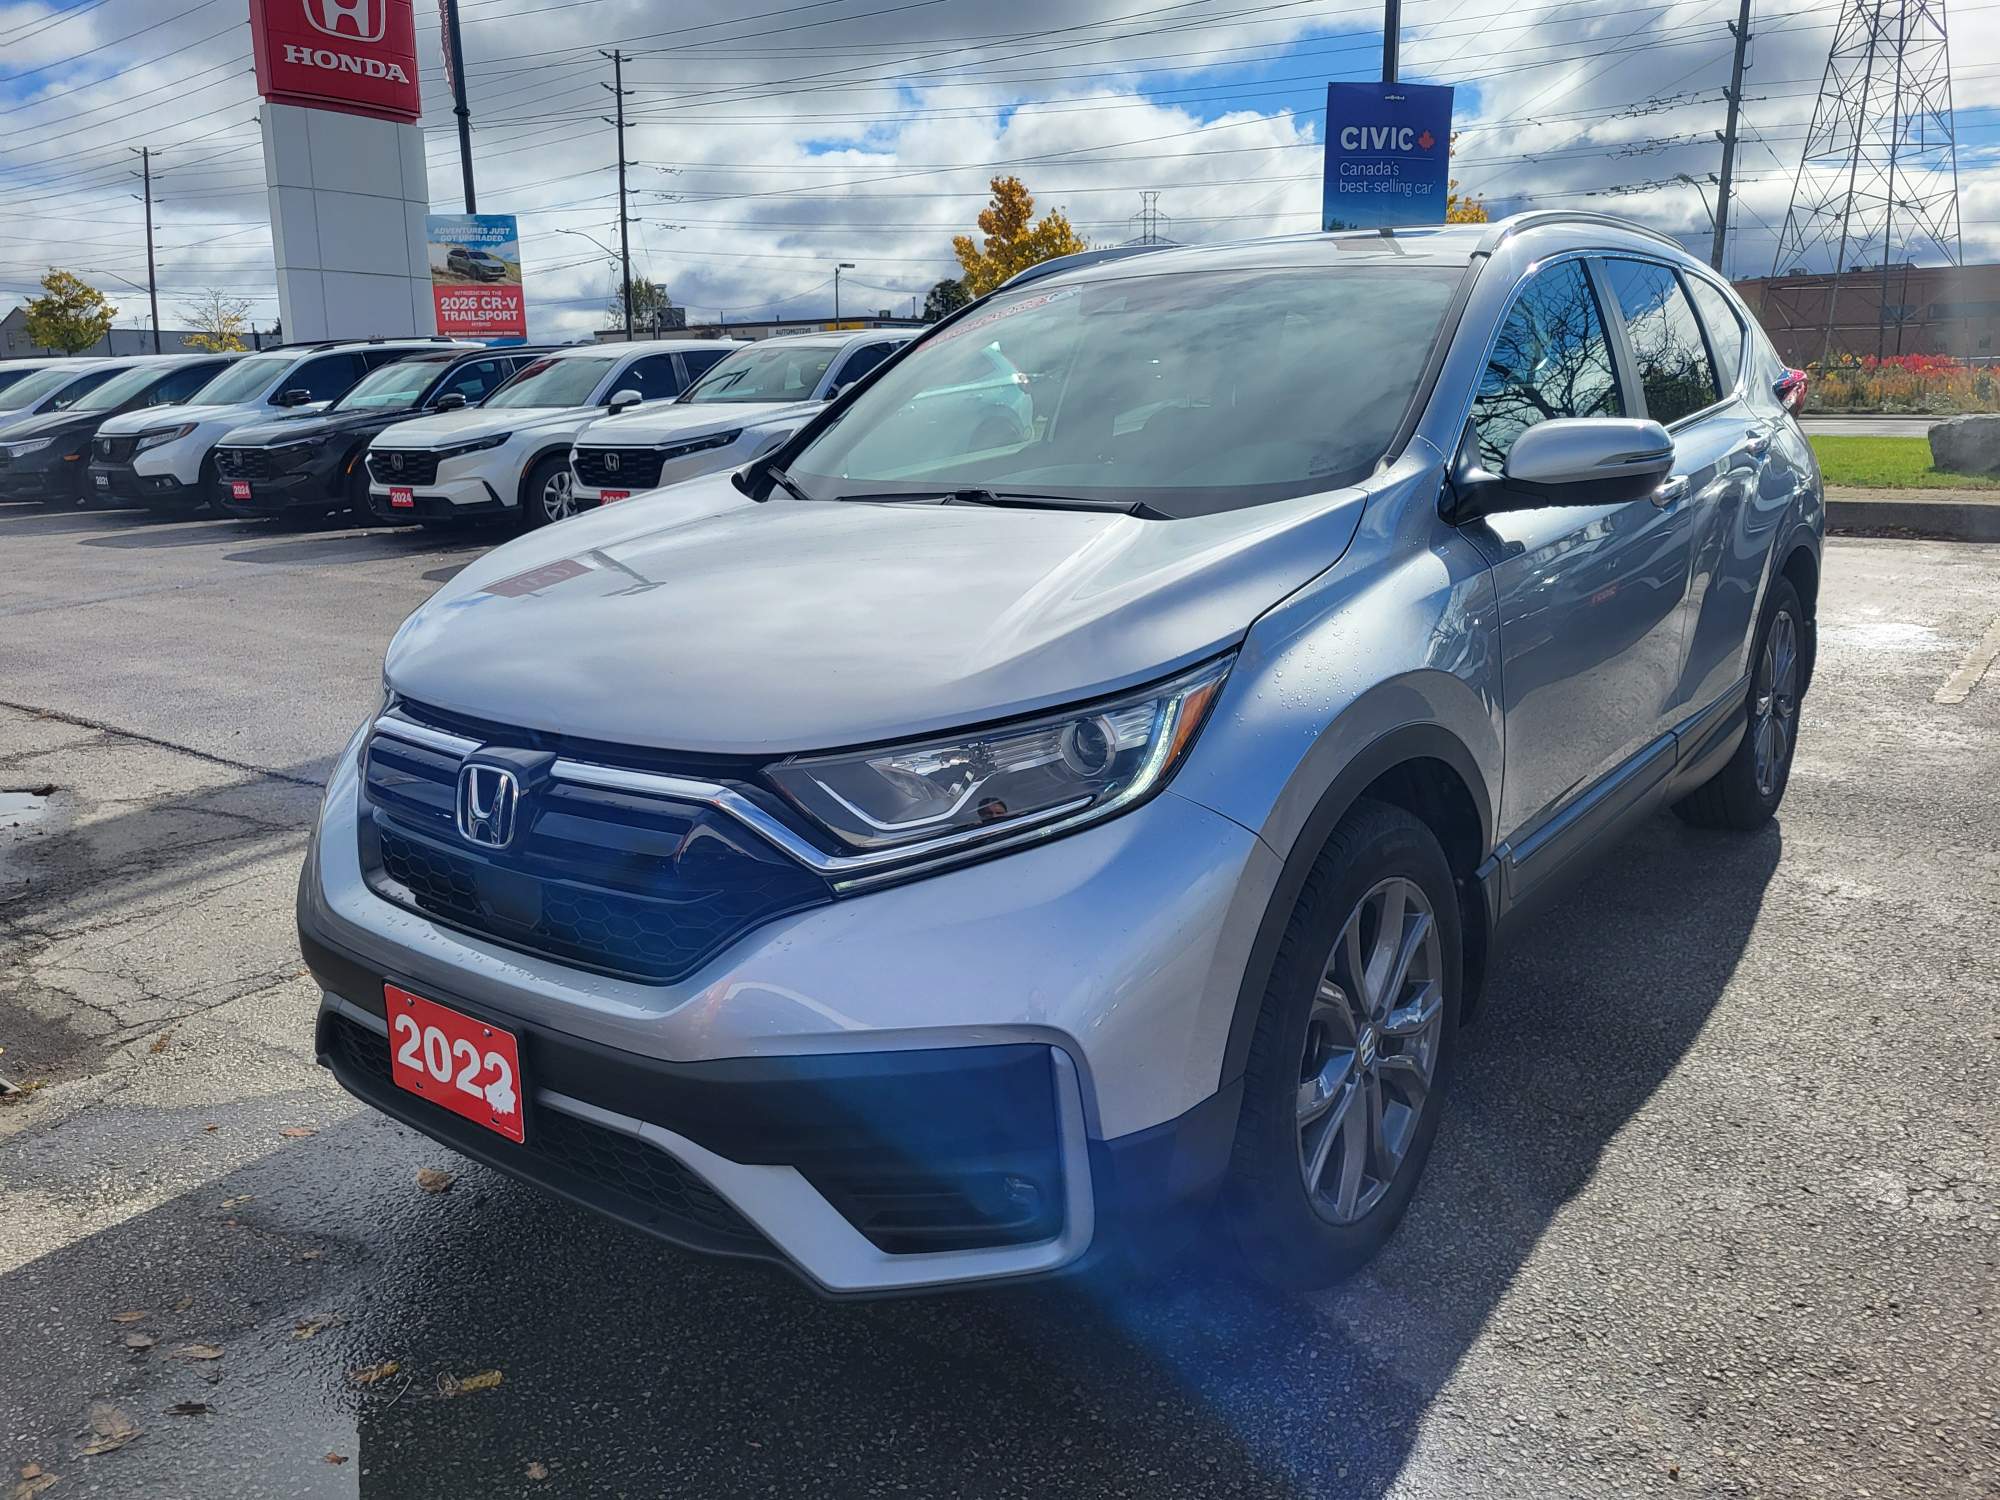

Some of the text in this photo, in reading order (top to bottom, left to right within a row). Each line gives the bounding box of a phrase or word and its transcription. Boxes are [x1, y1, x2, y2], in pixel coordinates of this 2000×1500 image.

[283, 44, 409, 84] HONDA
[1340, 127, 1414, 151] CIVIC
[1340, 161, 1399, 176] Canada's
[1340, 179, 1412, 197] best-selling
[441, 297, 517, 310] 2026 CR-V
[442, 310, 518, 321] TRAILSPORT
[391, 492, 412, 503] 2024
